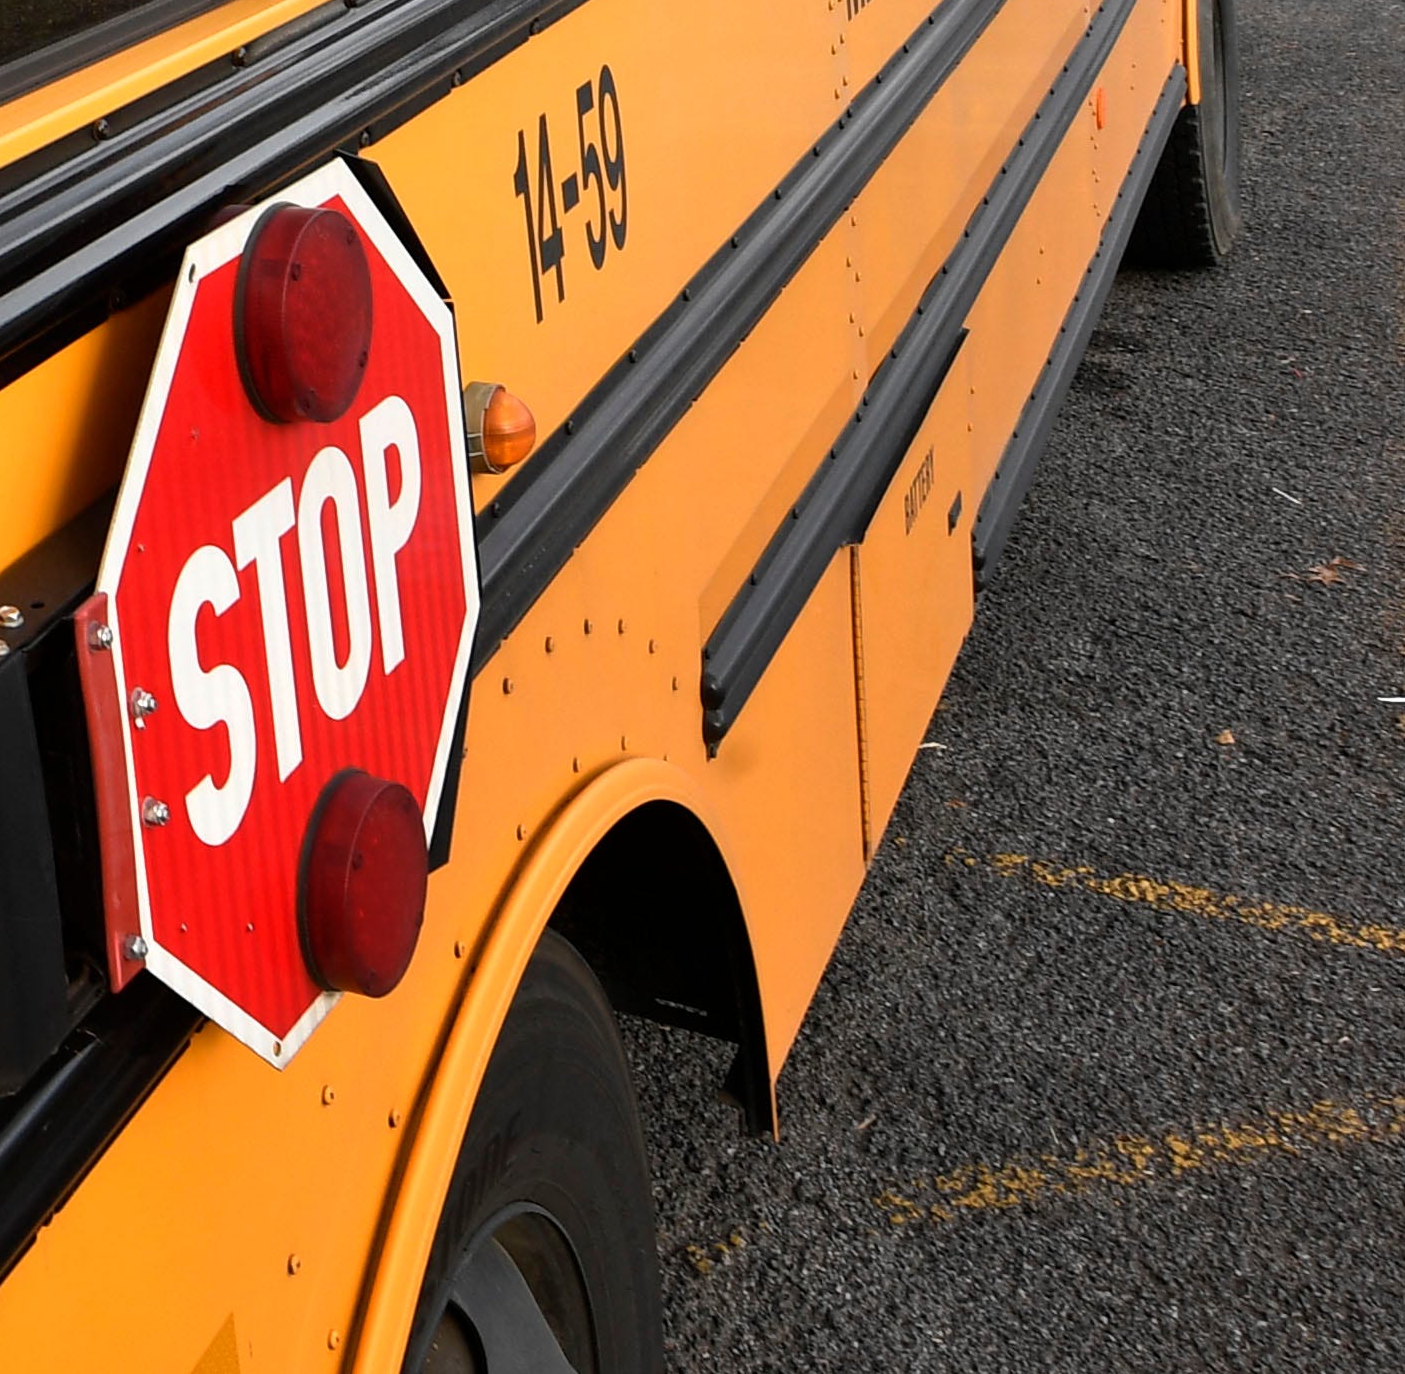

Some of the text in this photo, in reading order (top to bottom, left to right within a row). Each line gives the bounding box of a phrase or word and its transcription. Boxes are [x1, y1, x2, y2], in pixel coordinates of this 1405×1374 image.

[513, 64, 628, 325] 14-59
[167, 395, 424, 847] STOP
[904, 444, 935, 537] BATTERY
